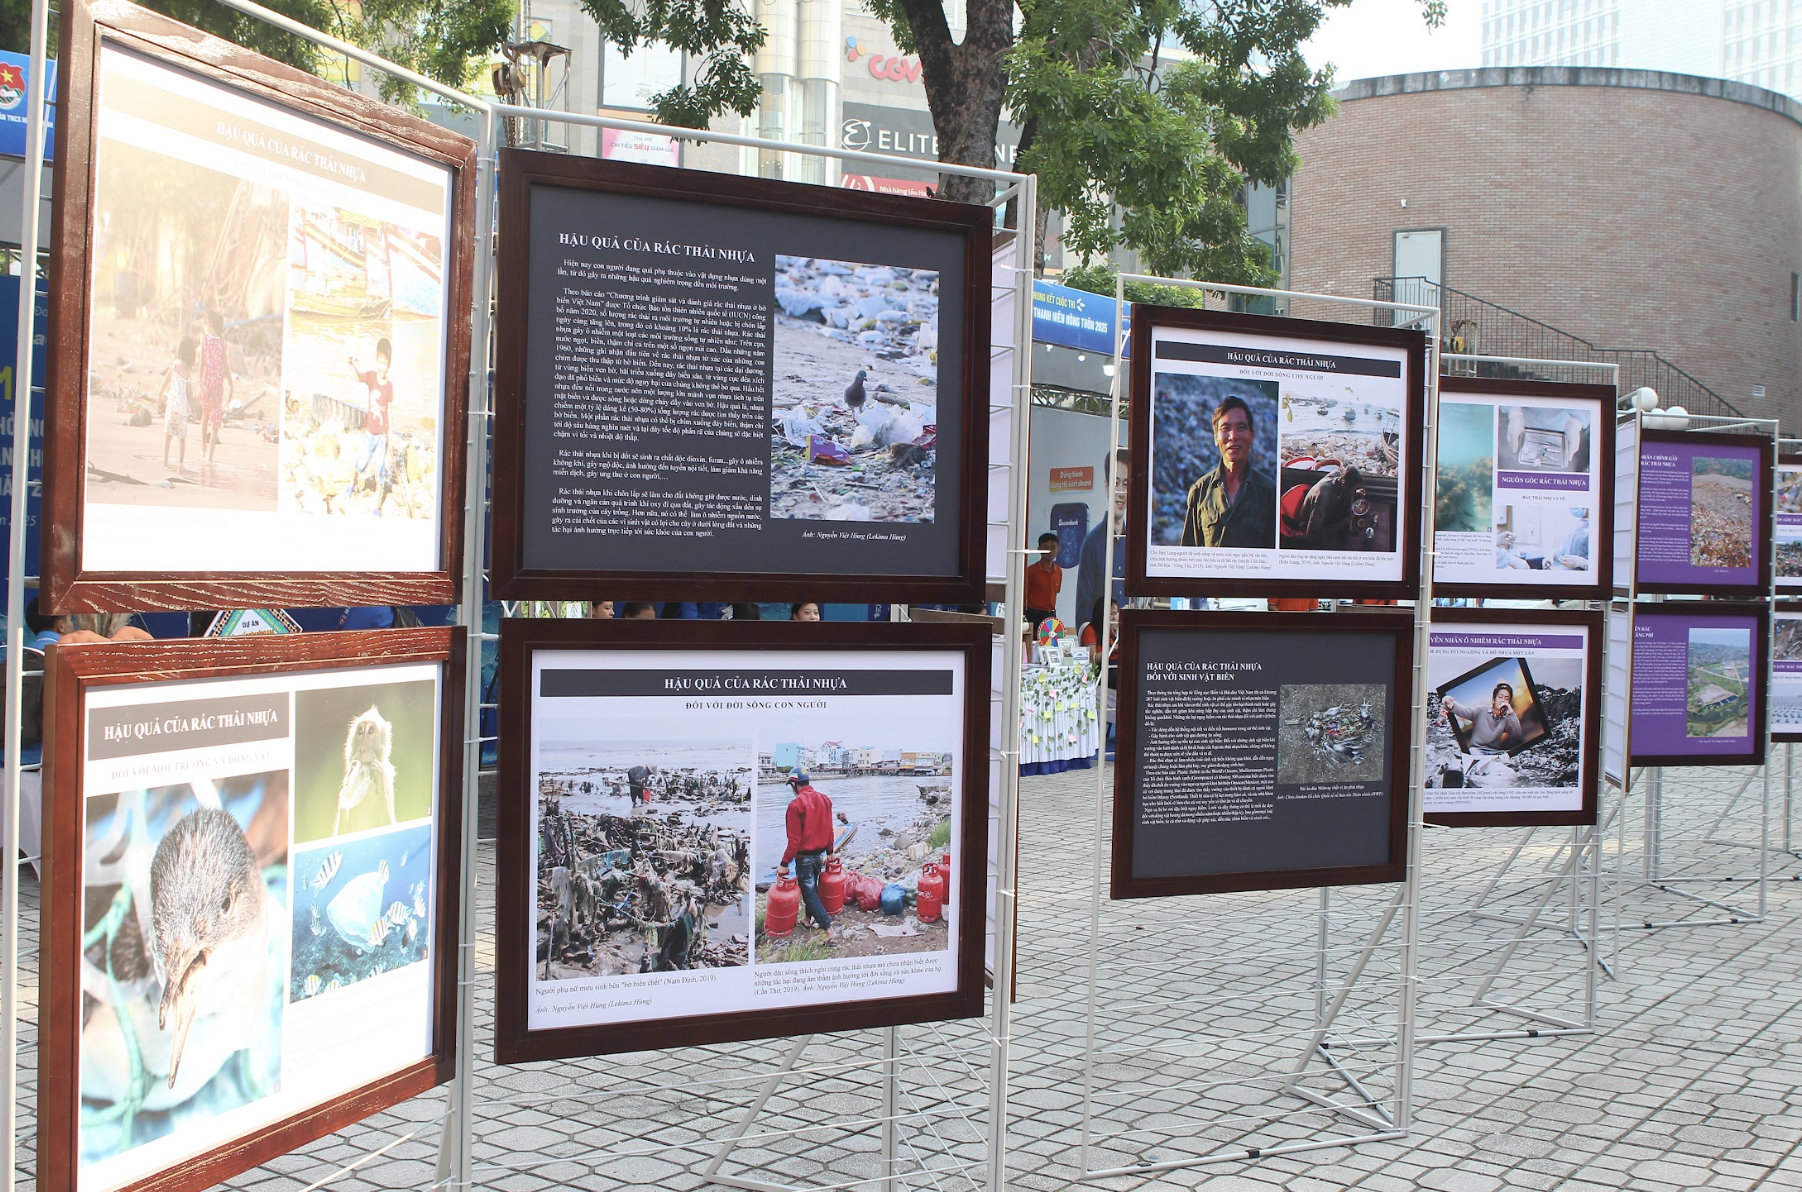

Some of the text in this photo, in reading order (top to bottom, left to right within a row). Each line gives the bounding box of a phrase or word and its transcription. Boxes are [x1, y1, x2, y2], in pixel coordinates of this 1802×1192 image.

[869, 54, 922, 83] CGV
[217, 120, 241, 140] HẬU
[243, 130, 266, 149] QUẢ
[268, 139, 289, 156] CỦA
[291, 146, 311, 164] RÁC
[315, 154, 337, 172] THẢI
[339, 162, 365, 182] NHỰA
[560, 233, 754, 263] HẬU QUẢ CỦA RÁC THẢI NHỰA
[1034, 307, 1052, 320] THANH
[1052, 311, 1065, 324] NIÊN
[1066, 314, 1080, 327] NÔNG
[1081, 317, 1095, 330] THÔN
[1095, 321, 1108, 333] 2025
[1228, 352, 1336, 369] HẬU QUẢ CỦA RÁC THẢI NHỰA
[1147, 661, 1262, 671] HẬU QUẢ CỦA RÁC THẢI NHỰA
[665, 676, 846, 691] HẬU QUẢ CỦA RÁC THẢI NHỰA
[1147, 672, 1161, 680] ĐỐI
[1164, 672, 1177, 680] VỚI
[1200, 673, 1214, 682] VẬT
[1217, 672, 1234, 680] BIỂN
[686, 701, 703, 709] ĐỐI
[797, 700, 826, 708] NGƯỜI
[105, 709, 278, 742] HẬU QUẢ CỦA RÁC THẢI NHỰA
